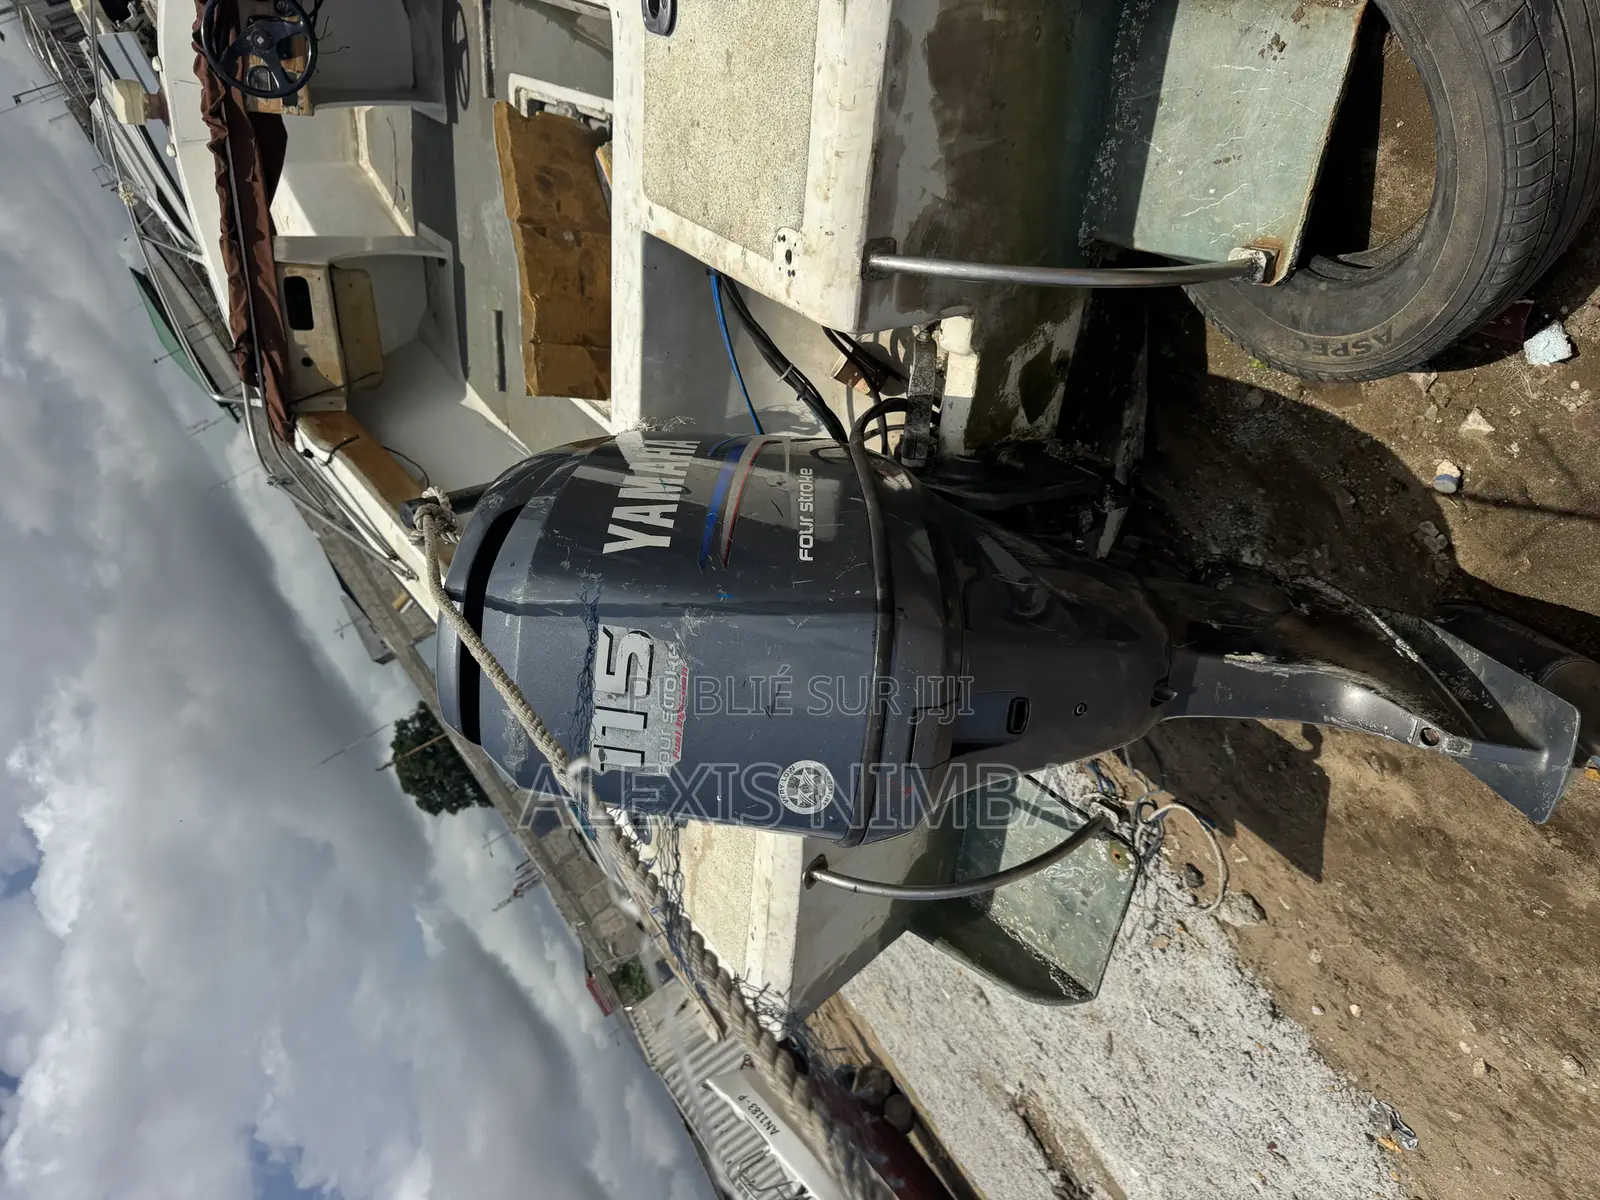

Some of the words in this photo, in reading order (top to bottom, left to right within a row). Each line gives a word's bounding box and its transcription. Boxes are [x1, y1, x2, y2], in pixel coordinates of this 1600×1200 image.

[1294, 324, 1393, 357] ASPEC
[602, 440, 701, 555] YAMAHA
[592, 624, 655, 774] 115
